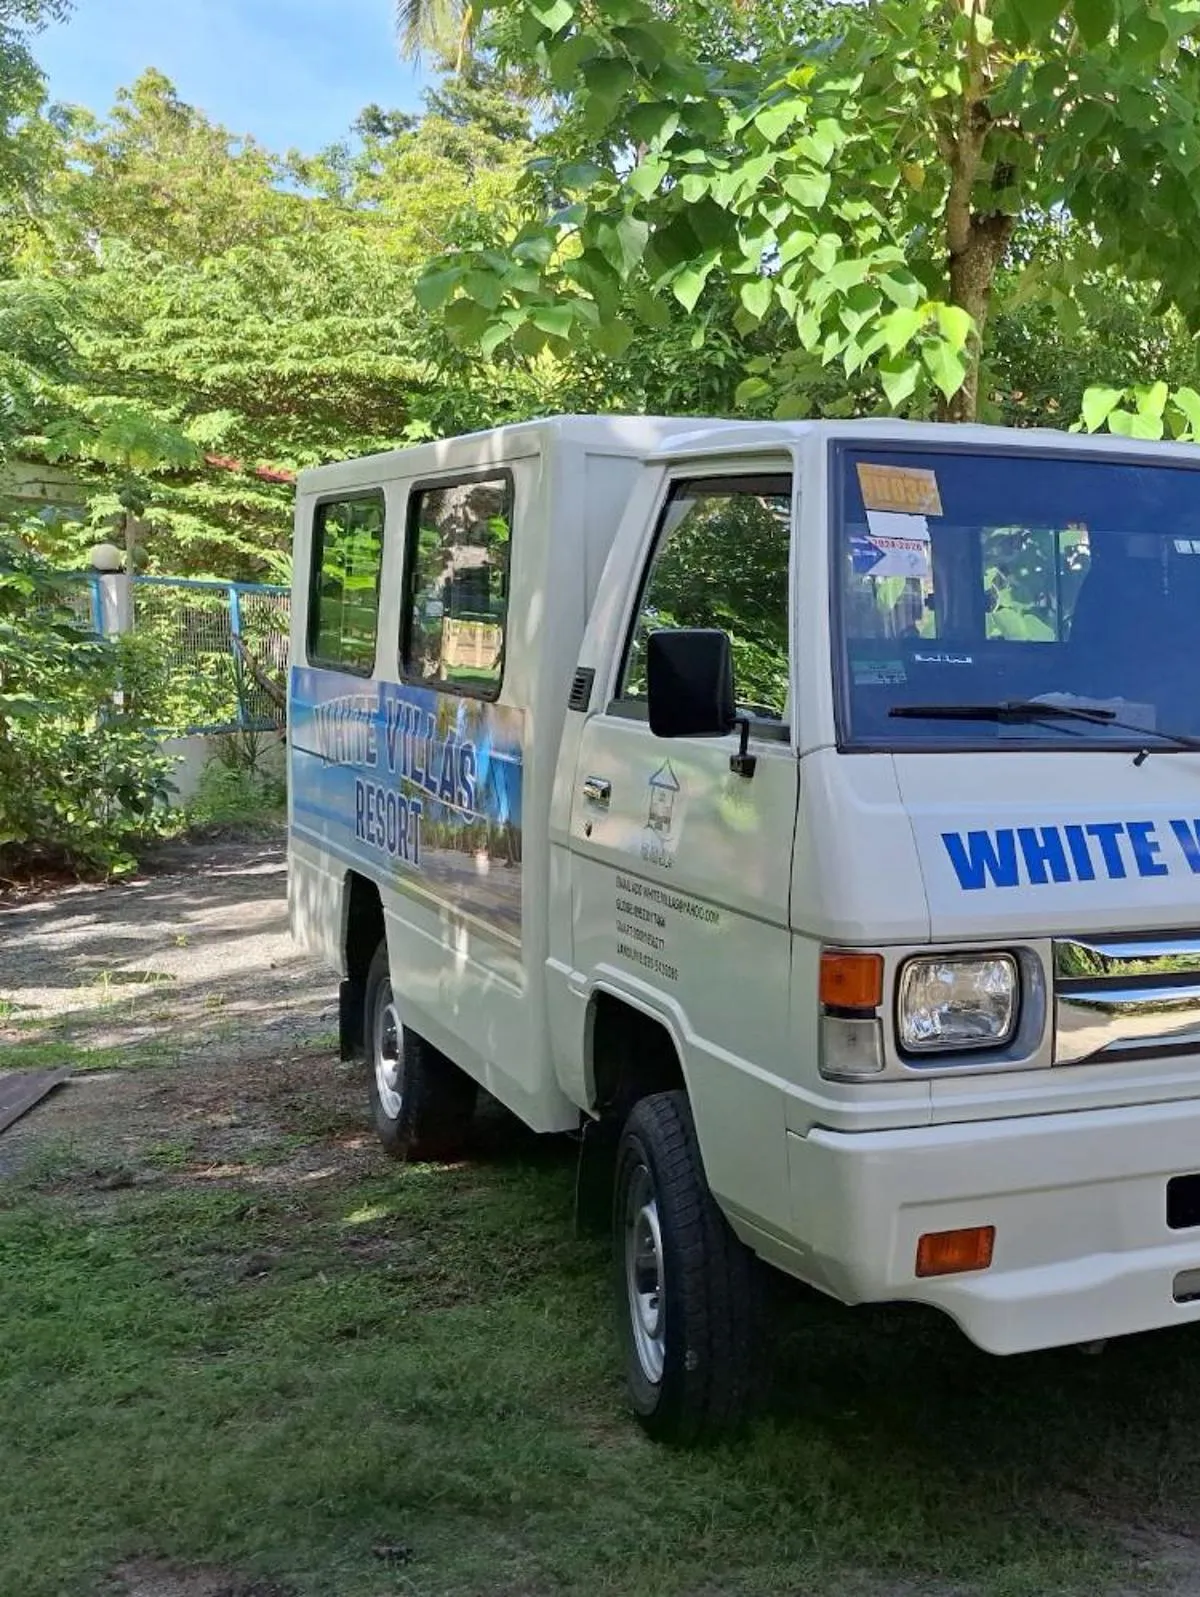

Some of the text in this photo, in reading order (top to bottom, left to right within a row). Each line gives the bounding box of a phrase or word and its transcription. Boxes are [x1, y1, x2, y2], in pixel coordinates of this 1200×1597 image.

[384, 697, 478, 825] VILLAS
[355, 775, 424, 871] RESORT
[941, 821, 1169, 890] WHITE
